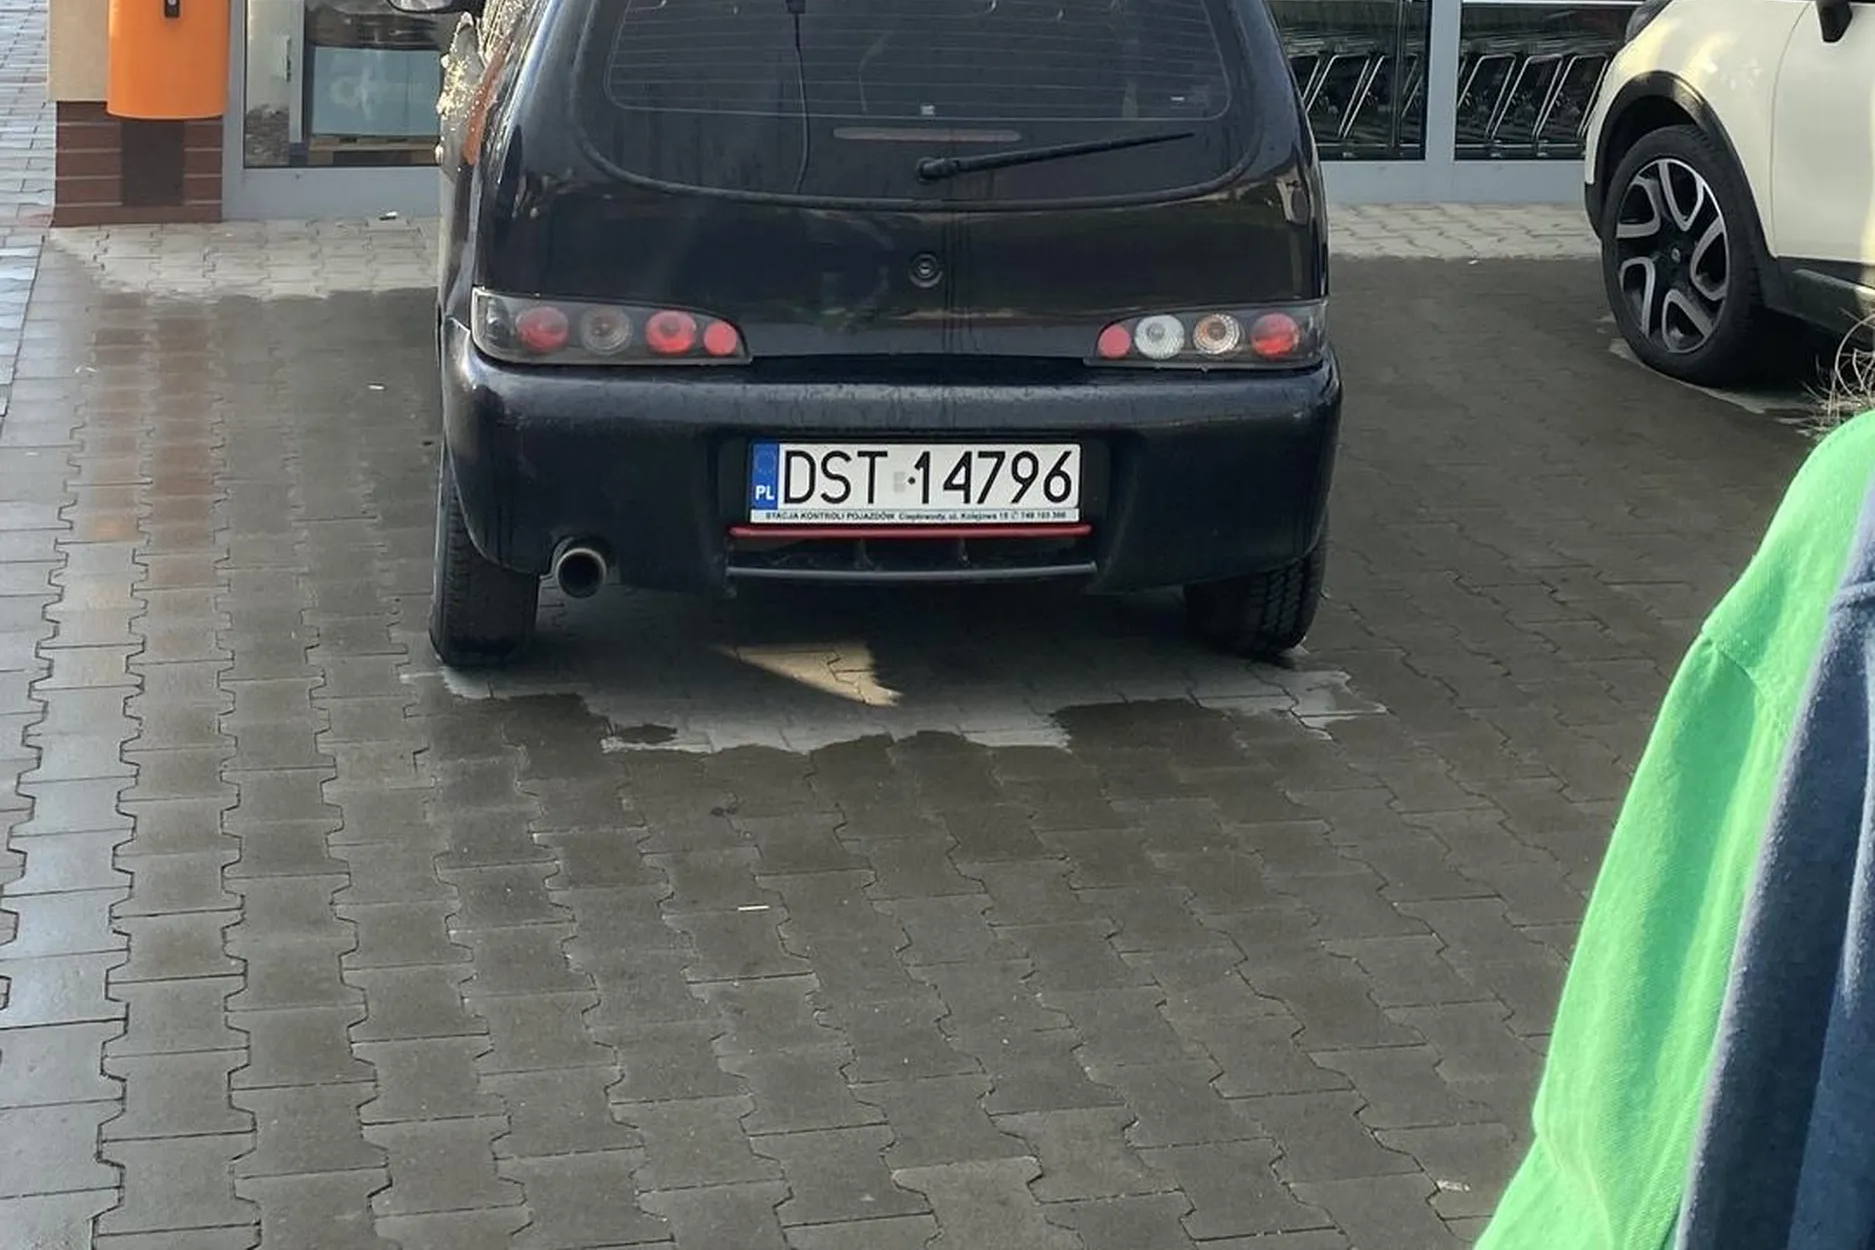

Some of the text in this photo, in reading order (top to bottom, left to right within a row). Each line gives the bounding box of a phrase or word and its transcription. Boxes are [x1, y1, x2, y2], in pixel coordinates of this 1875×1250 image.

[783, 450, 1073, 505] DST 14796
[755, 484, 775, 501] PL
[765, 512, 798, 520] STACJA
[801, 512, 845, 520] KONTROLI
